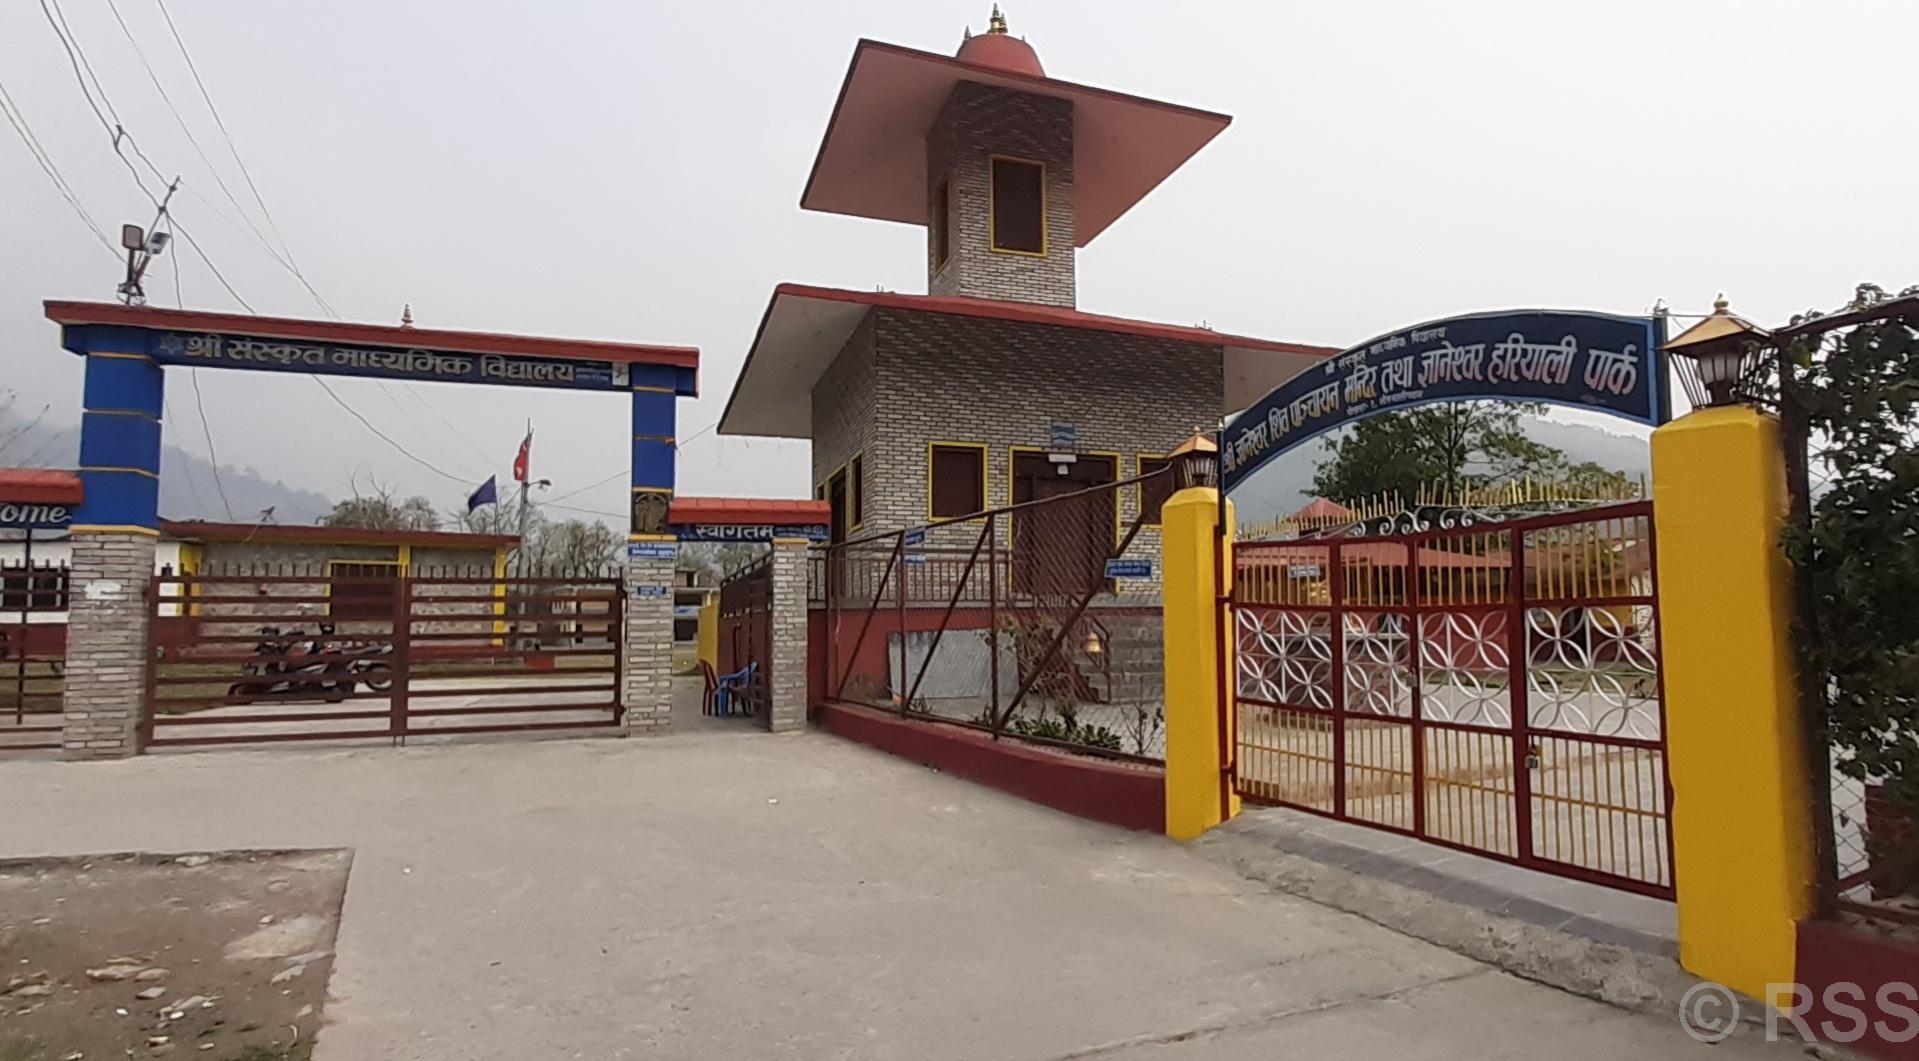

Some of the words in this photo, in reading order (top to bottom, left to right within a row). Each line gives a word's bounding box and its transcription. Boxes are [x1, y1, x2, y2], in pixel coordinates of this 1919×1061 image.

[185, 335, 223, 359] श्री
[227, 339, 326, 365] संस्कृत
[331, 347, 473, 375] माध्यमिक
[479, 354, 577, 382] विद्यालय
[1268, 405, 1291, 442] शिव
[1344, 365, 1379, 404] मन्दिर
[1381, 355, 1415, 394] तथा
[1488, 332, 1578, 385] हरियाली
[1584, 344, 1639, 396] पार्क
[0, 504, 73, 524] ome
